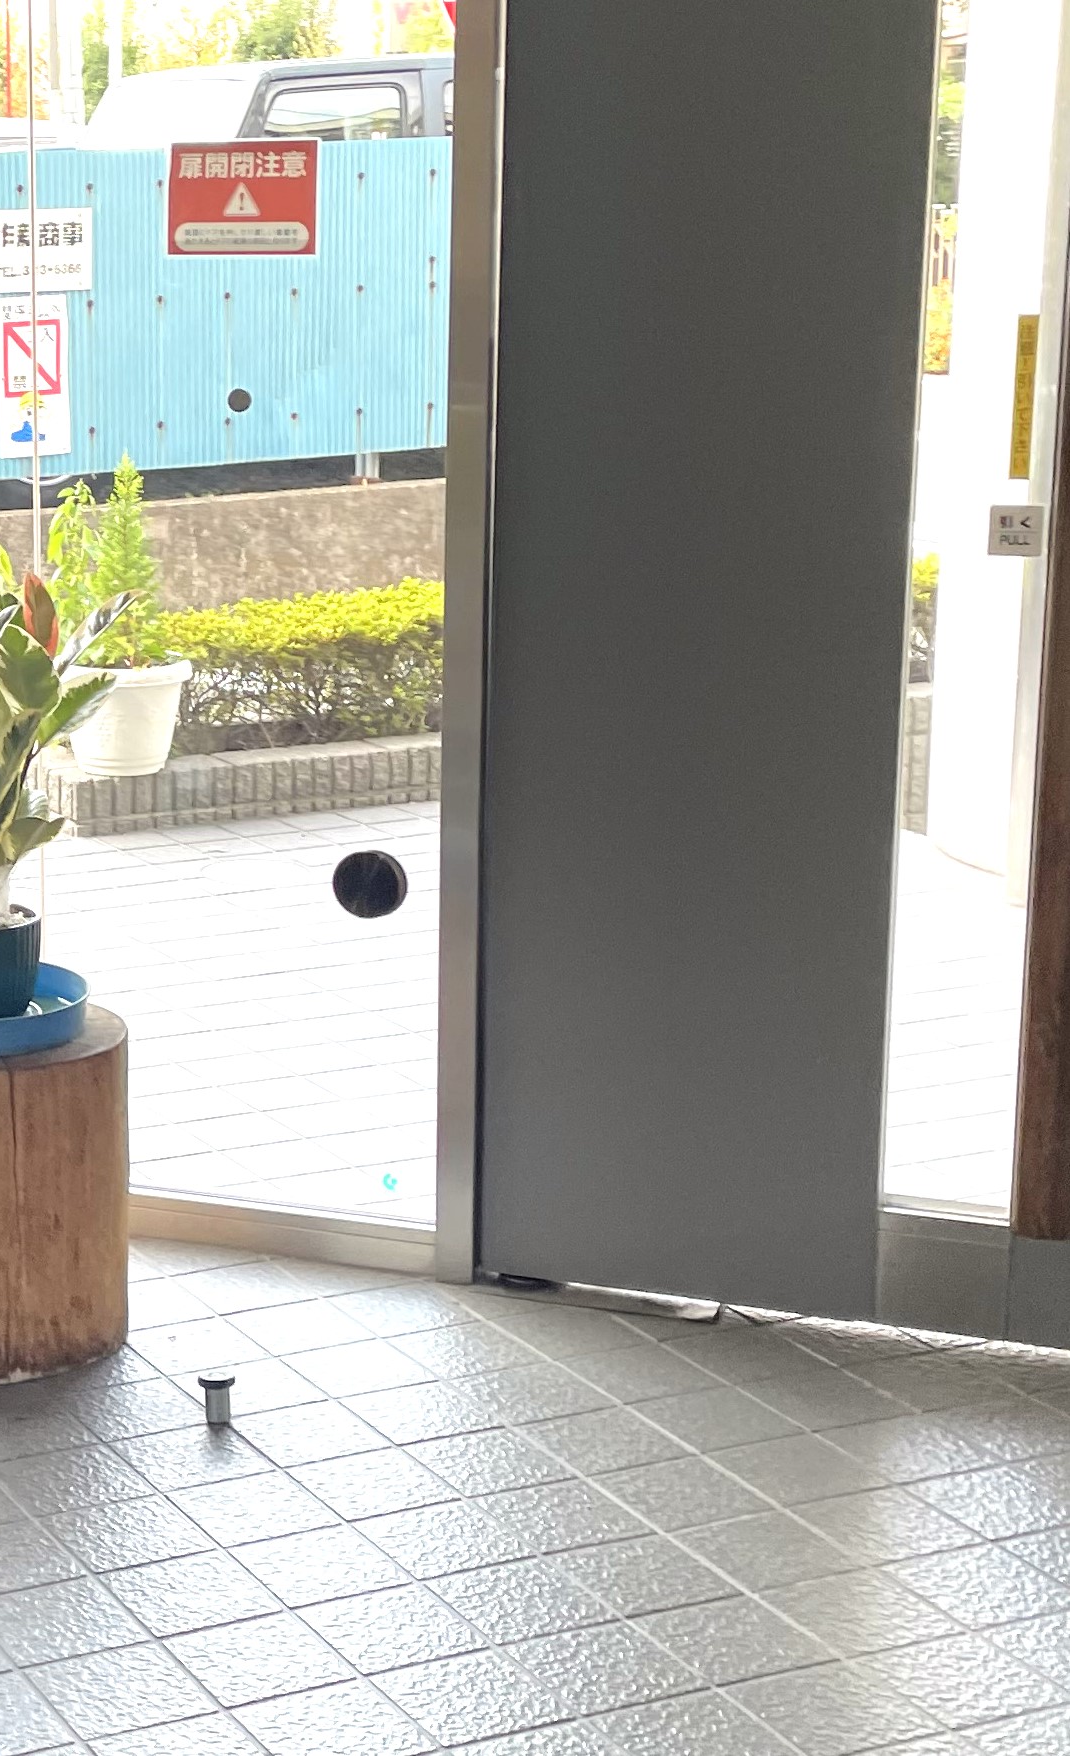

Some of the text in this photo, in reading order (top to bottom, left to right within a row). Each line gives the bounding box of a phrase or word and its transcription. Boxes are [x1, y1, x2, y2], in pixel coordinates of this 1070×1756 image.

[179, 151, 307, 179] 扉開閉注意
[999, 516, 1031, 529] 引く
[999, 534, 1031, 546] PULL
